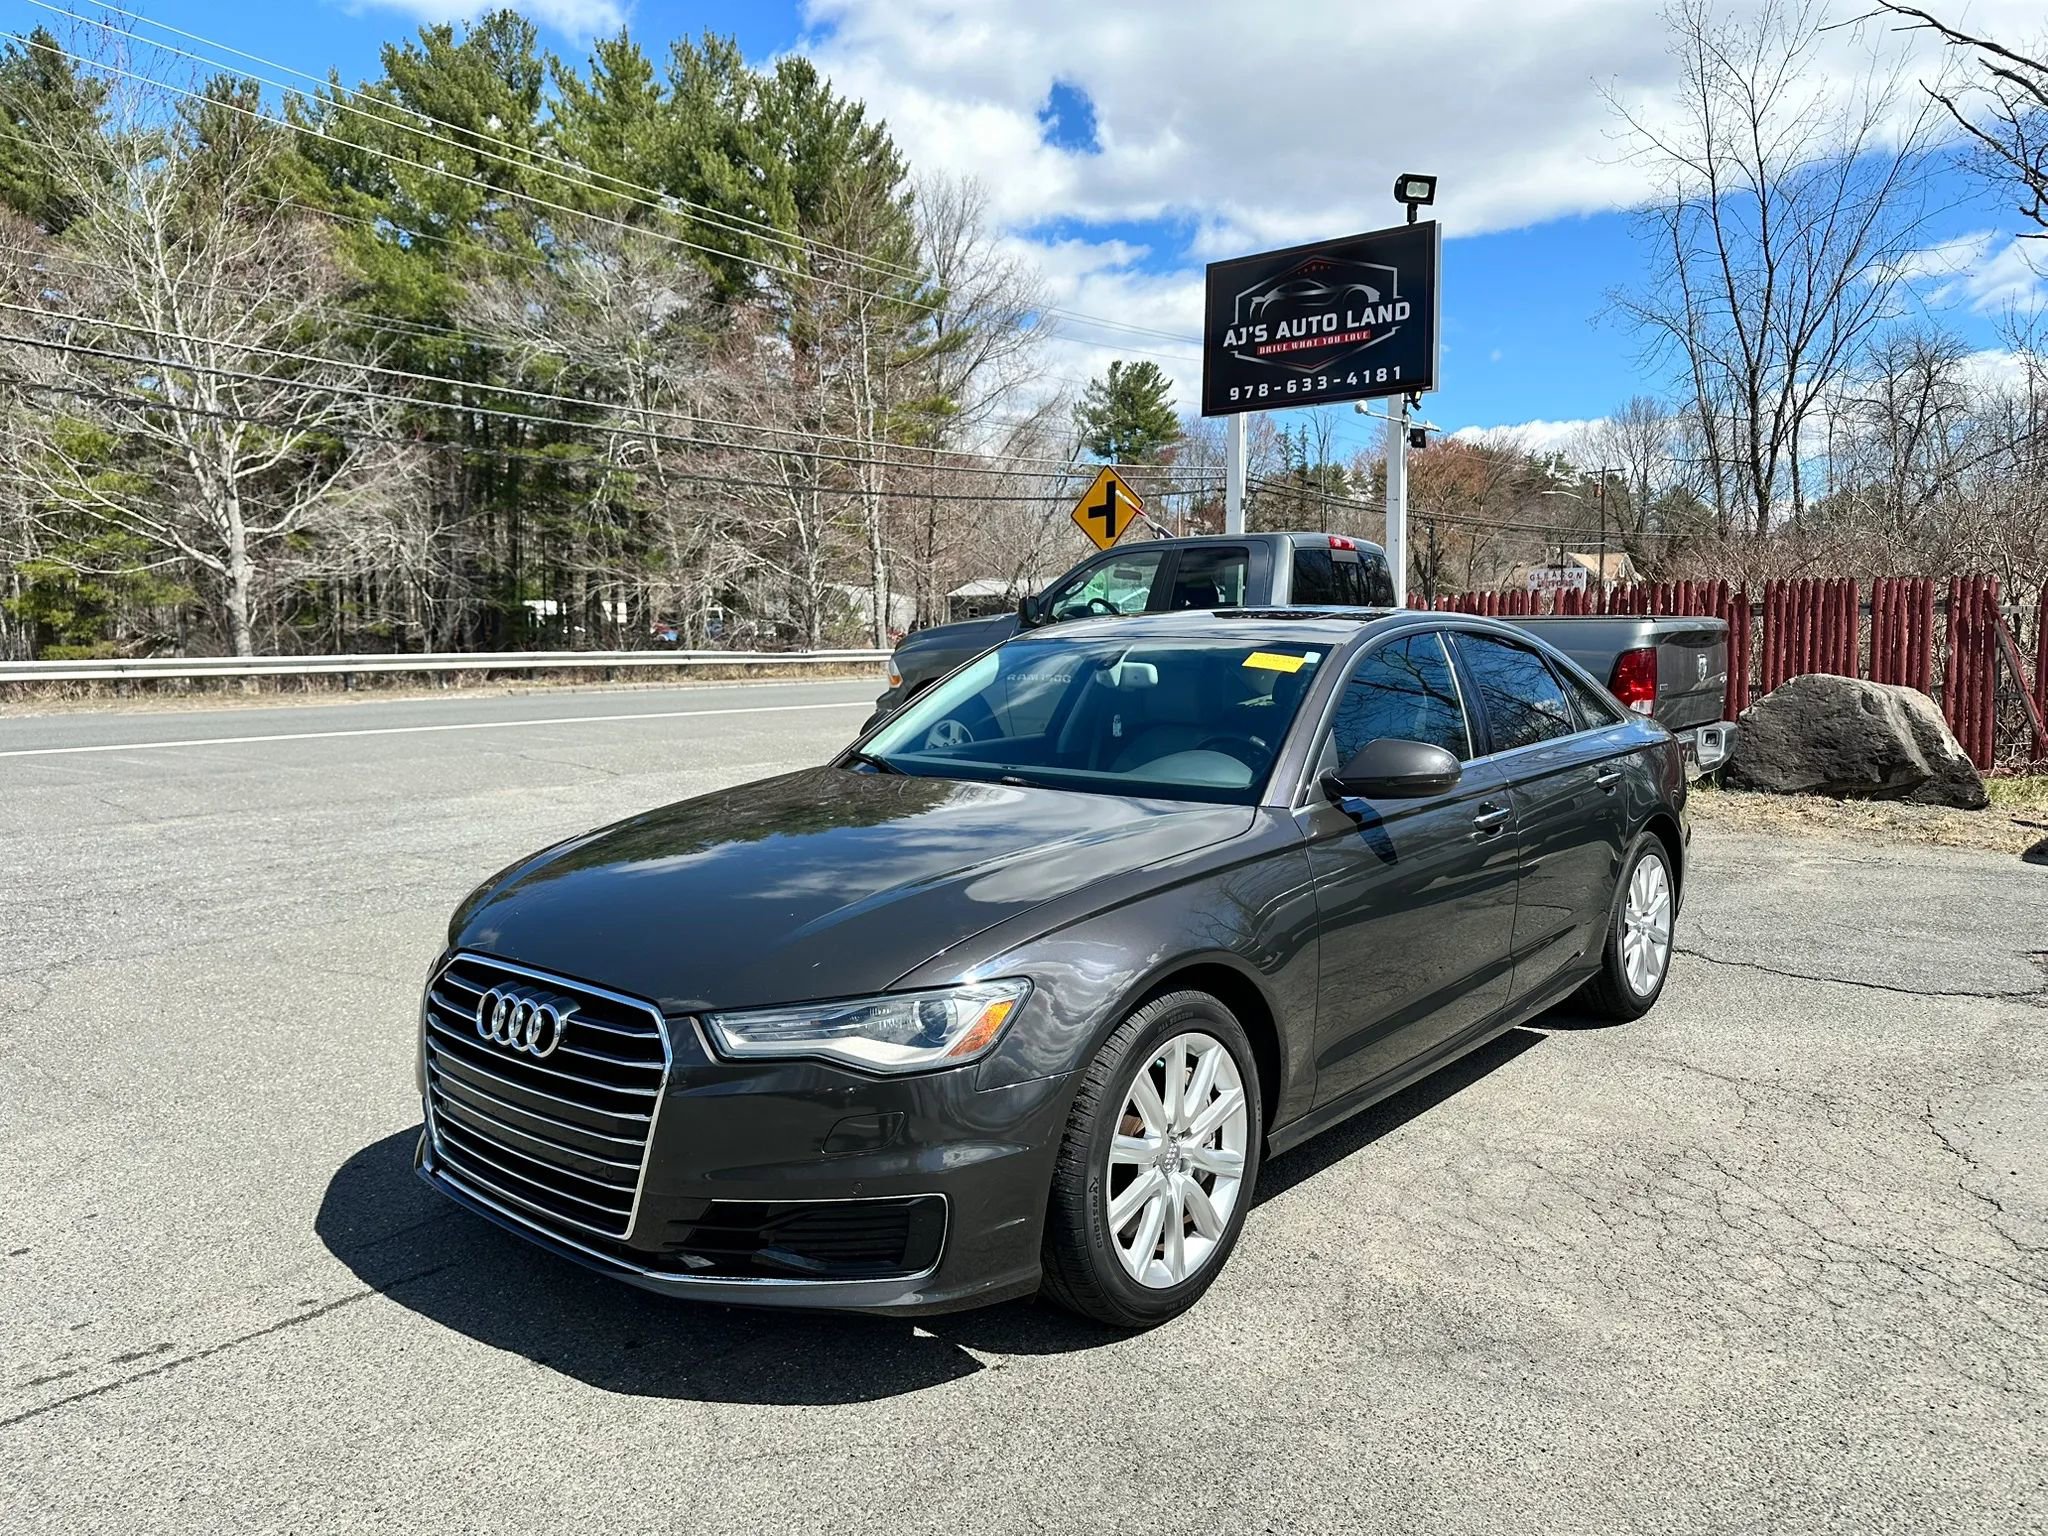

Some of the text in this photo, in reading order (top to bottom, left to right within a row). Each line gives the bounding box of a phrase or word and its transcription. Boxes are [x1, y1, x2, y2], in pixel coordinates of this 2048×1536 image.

[1223, 301, 1411, 347] AJ'S AUTO LAND
[1259, 331, 1369, 355] DRIVE WHAT YOU LOVE
[1229, 366, 1402, 401] 978-633-4181
[1006, 673, 1039, 681] RAM
